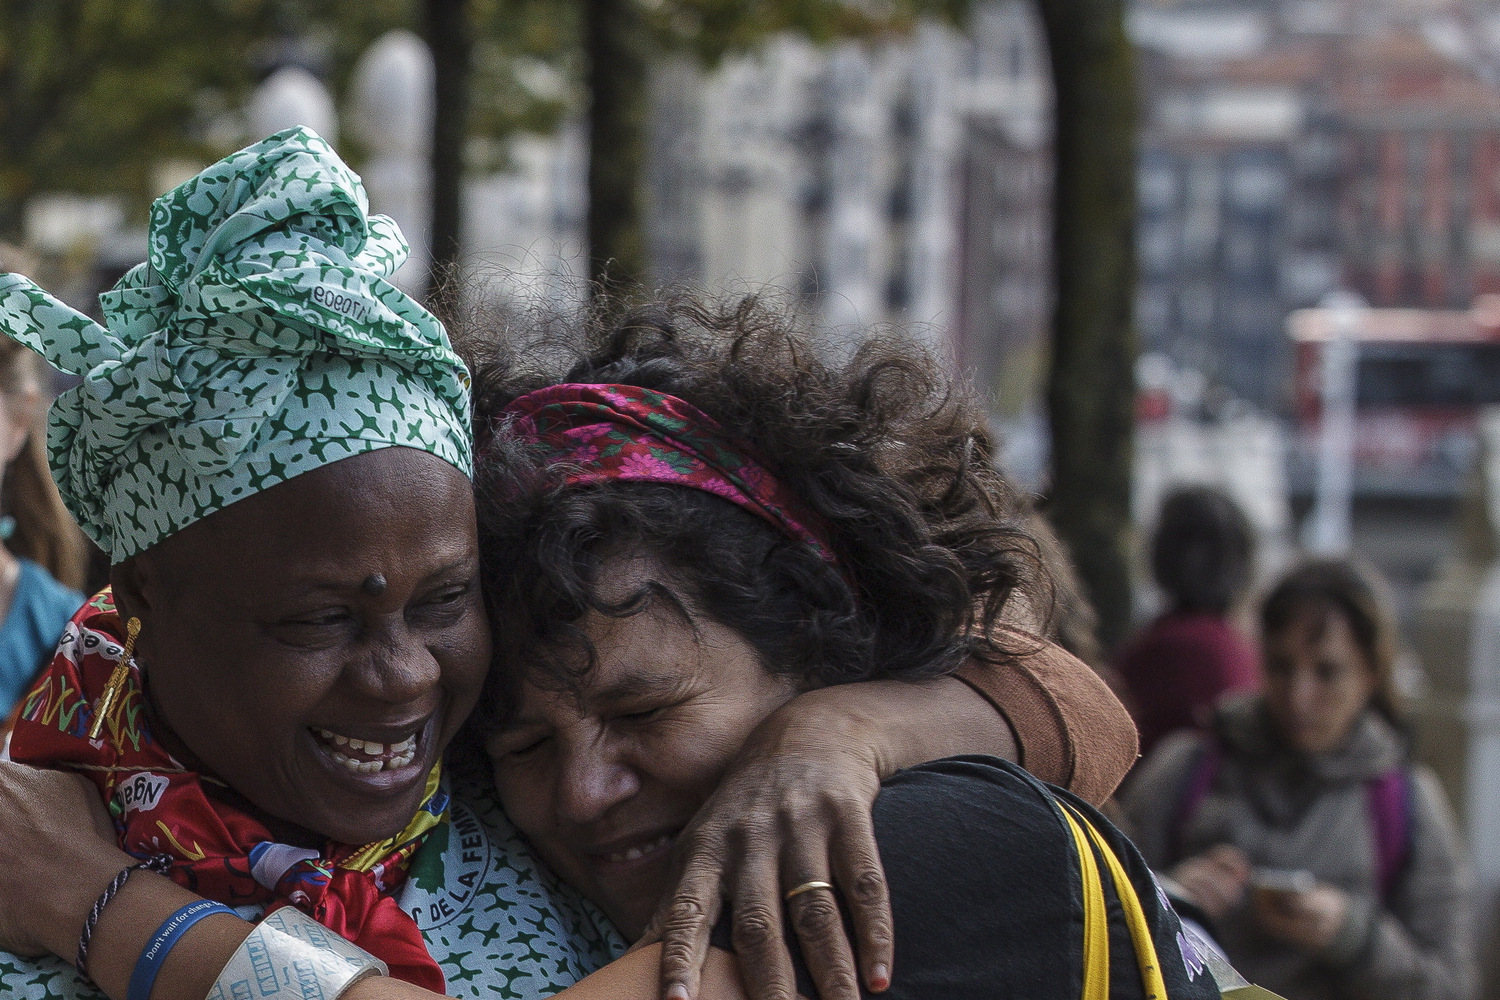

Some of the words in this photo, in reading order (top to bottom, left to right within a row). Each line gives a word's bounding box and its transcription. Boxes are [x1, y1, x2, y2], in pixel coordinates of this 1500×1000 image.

[429, 897, 456, 922] DE
[448, 870, 480, 903] LA
[146, 936, 165, 961] Don't
[162, 921, 179, 938] wait
[175, 912, 189, 923] for
